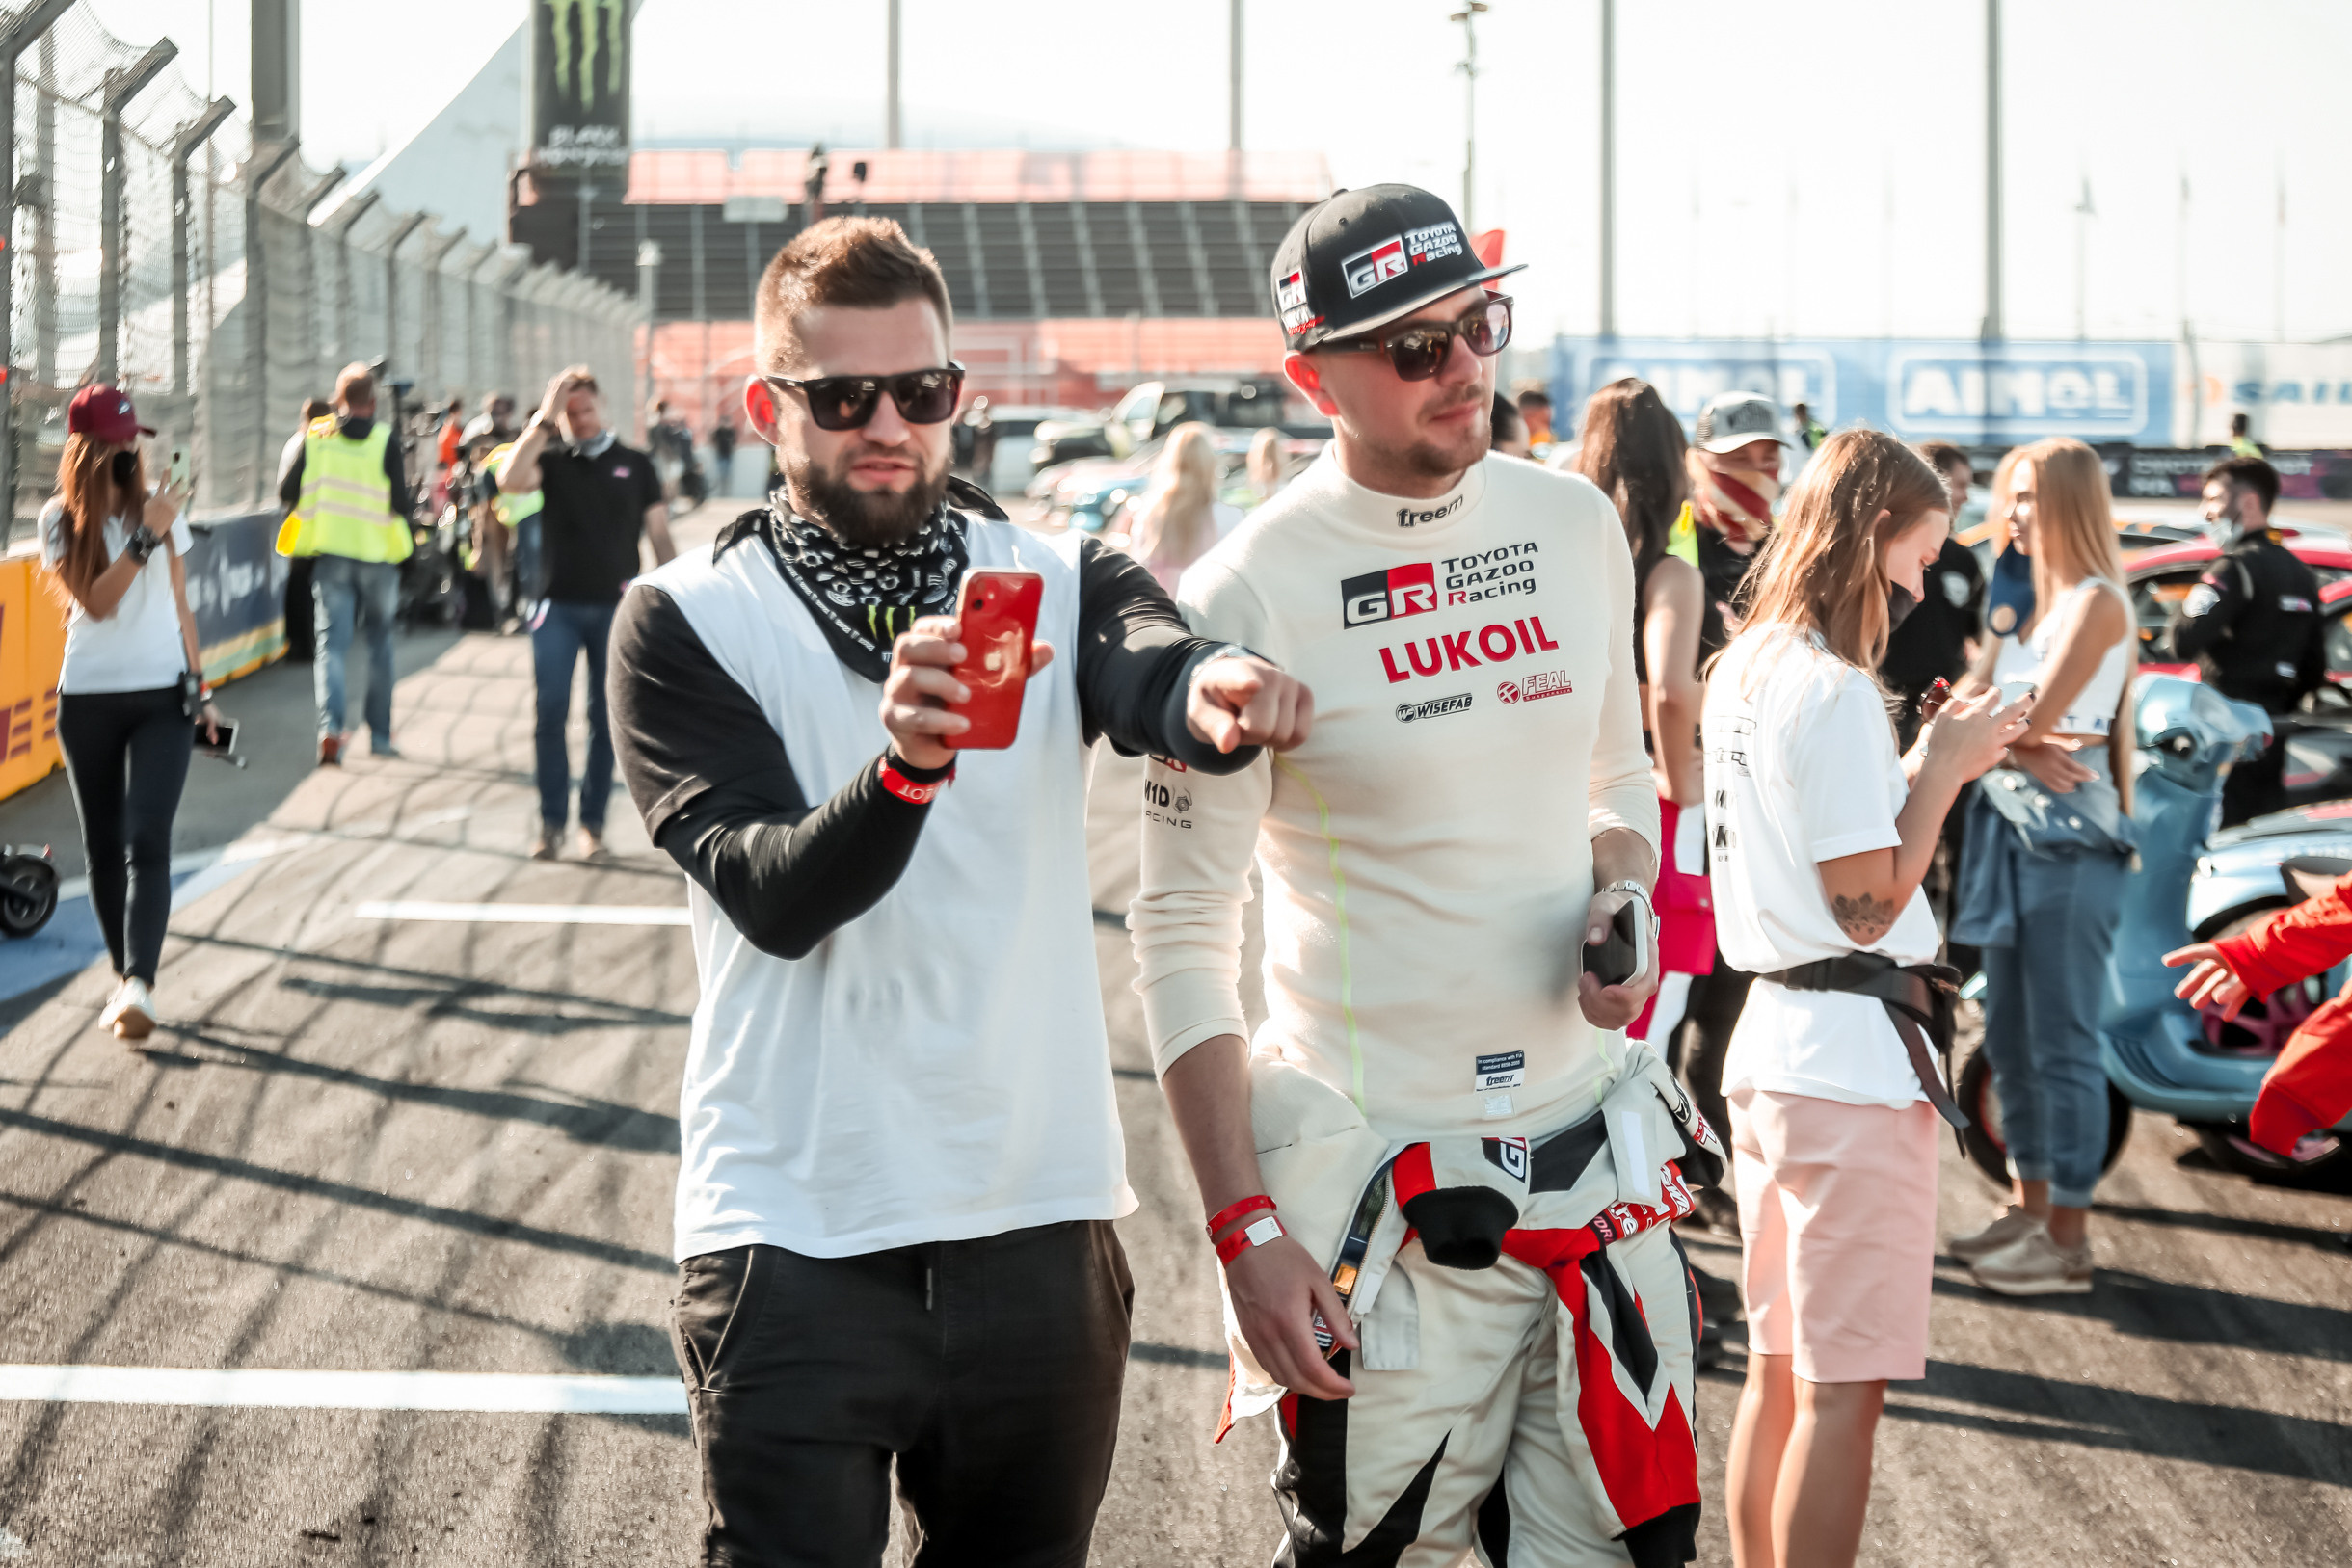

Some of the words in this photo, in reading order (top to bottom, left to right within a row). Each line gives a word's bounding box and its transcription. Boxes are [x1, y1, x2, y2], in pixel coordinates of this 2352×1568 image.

[1405, 222, 1457, 244] TOYOTA
[1409, 233, 1457, 256] GAZOO
[1412, 243, 1463, 266] Racing
[1350, 252, 1405, 295] GR
[1441, 542, 1538, 573] TOYOTA
[1446, 560, 1534, 590] GAZOO
[1347, 583, 1435, 625] GR
[1448, 578, 1537, 606] Racing
[1378, 616, 1560, 684] LUKOIL
[1522, 670, 1571, 696] FEAL
[1417, 696, 1473, 718] WISEFAB
[1485, 1074, 1514, 1086] freem
